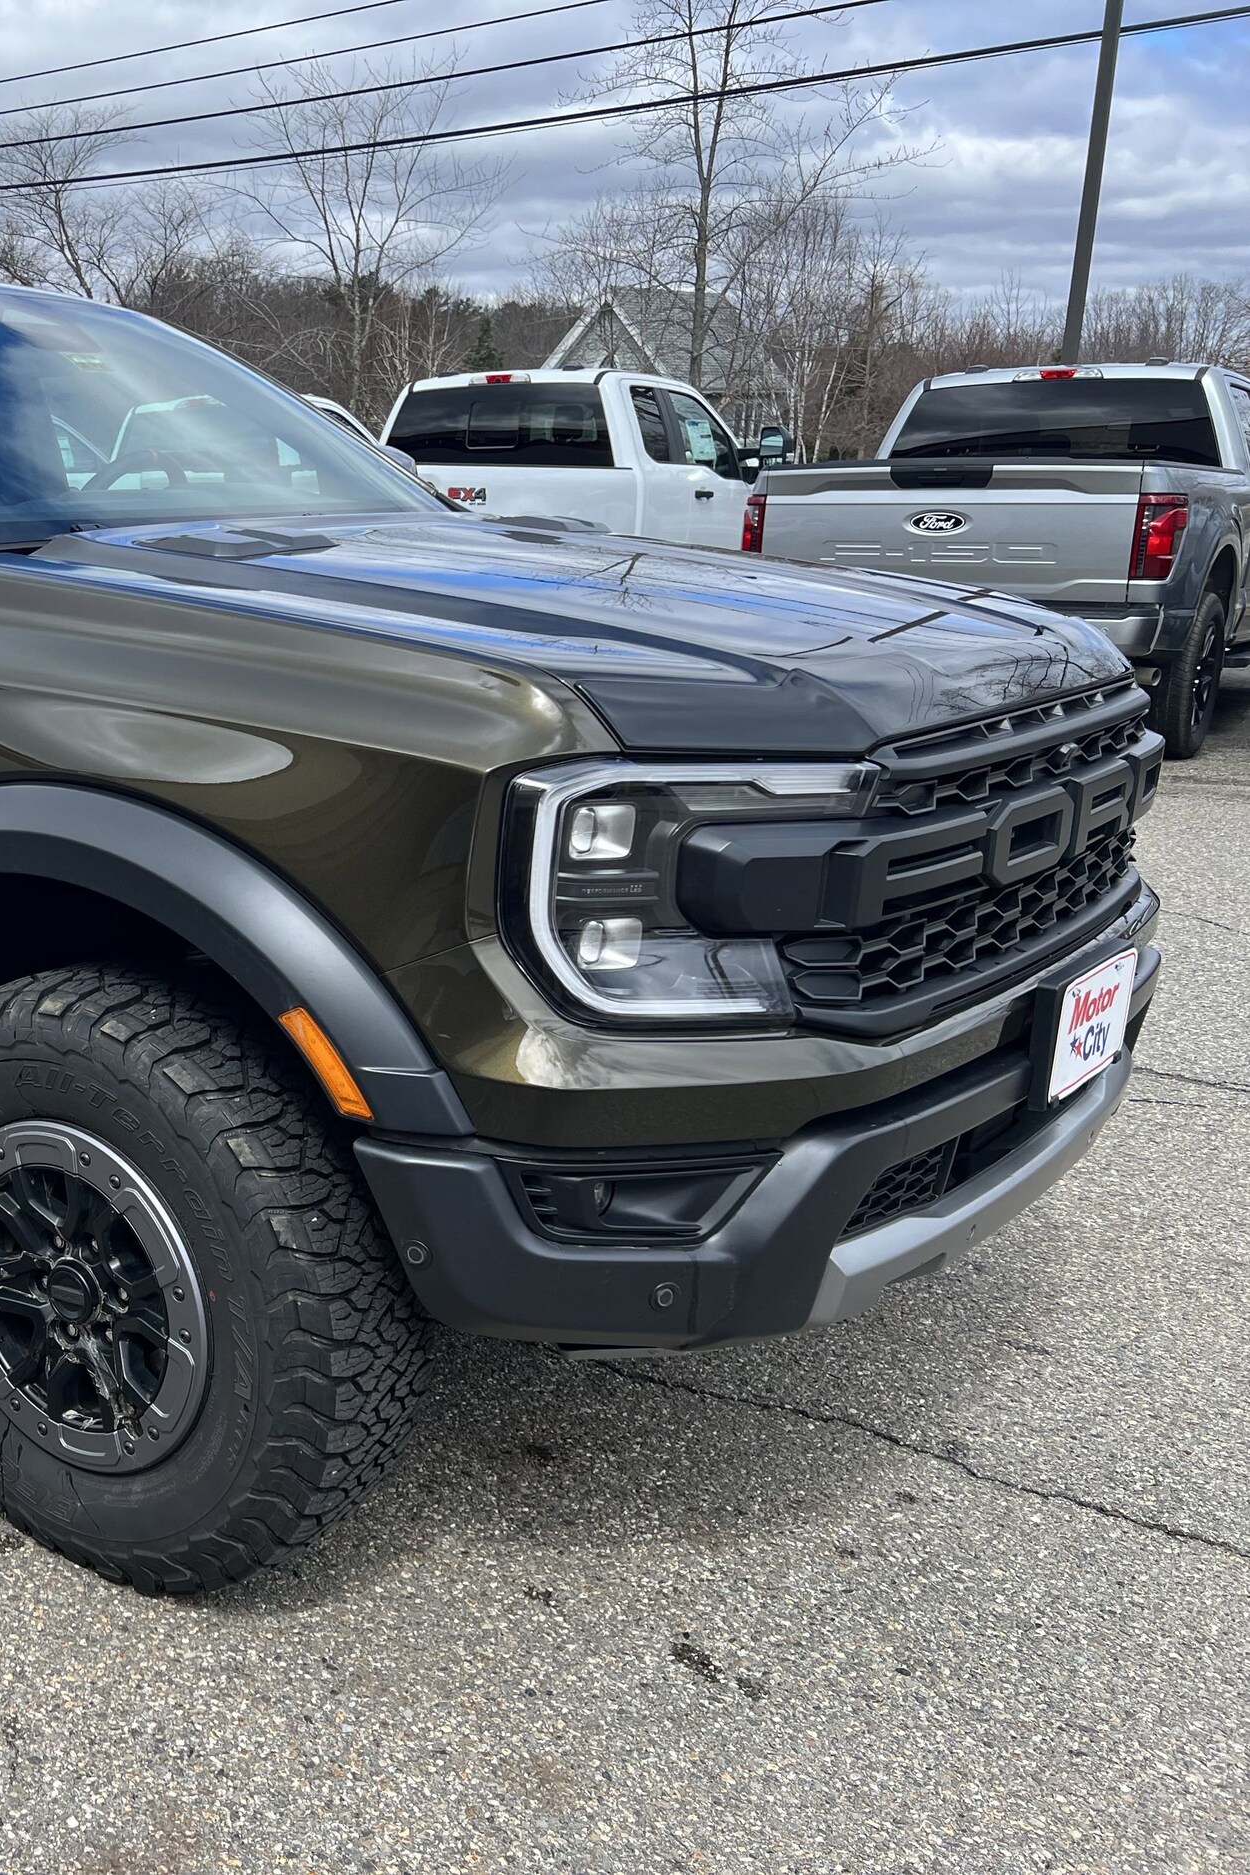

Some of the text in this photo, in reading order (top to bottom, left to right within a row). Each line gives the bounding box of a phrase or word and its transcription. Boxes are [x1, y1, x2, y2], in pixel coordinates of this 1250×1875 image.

[918, 512, 956, 531] Ford
[840, 730, 1166, 930] FORD
[1067, 982, 1121, 1036] Motor
[1082, 1021, 1111, 1062] City
